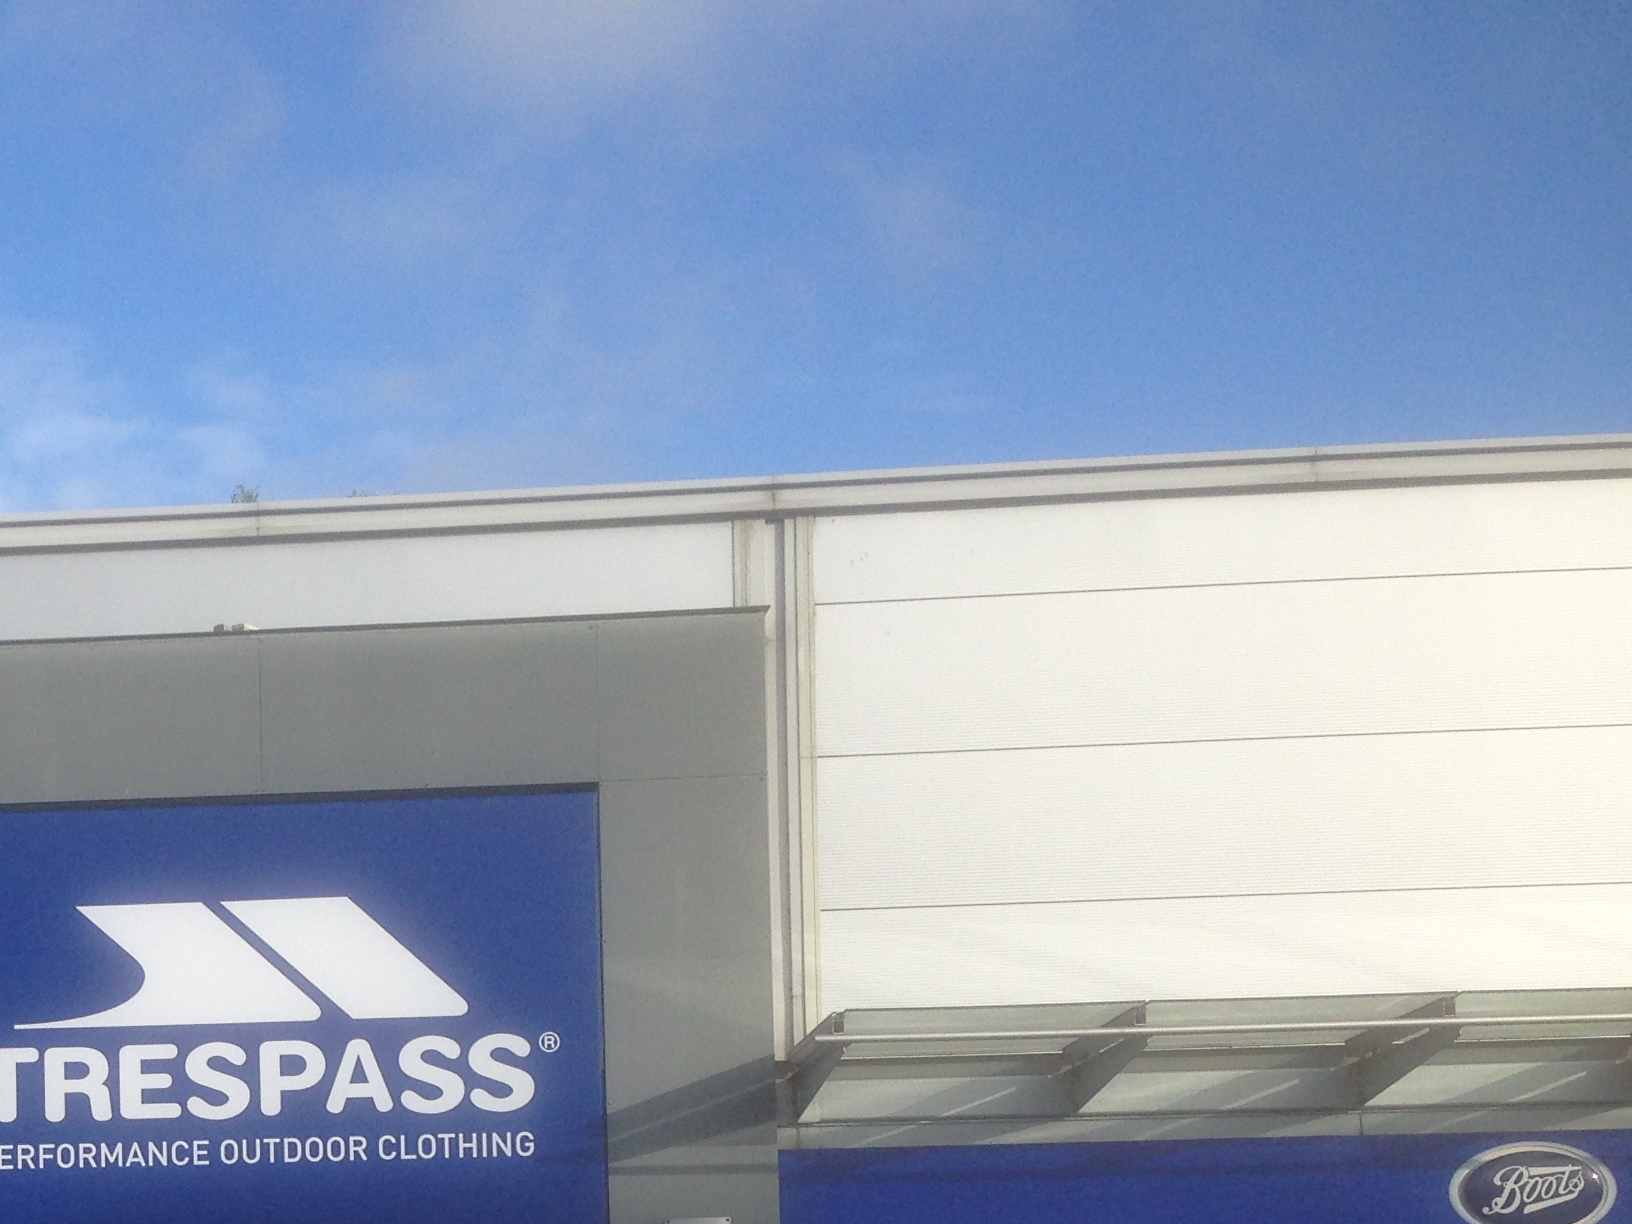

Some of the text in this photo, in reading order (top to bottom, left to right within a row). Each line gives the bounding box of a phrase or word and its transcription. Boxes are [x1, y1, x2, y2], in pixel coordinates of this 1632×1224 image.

[219, 1136, 368, 1164] OUTDOOR
[377, 1131, 536, 1161] CLOTHING
[1481, 1165, 1585, 1216] Boots
